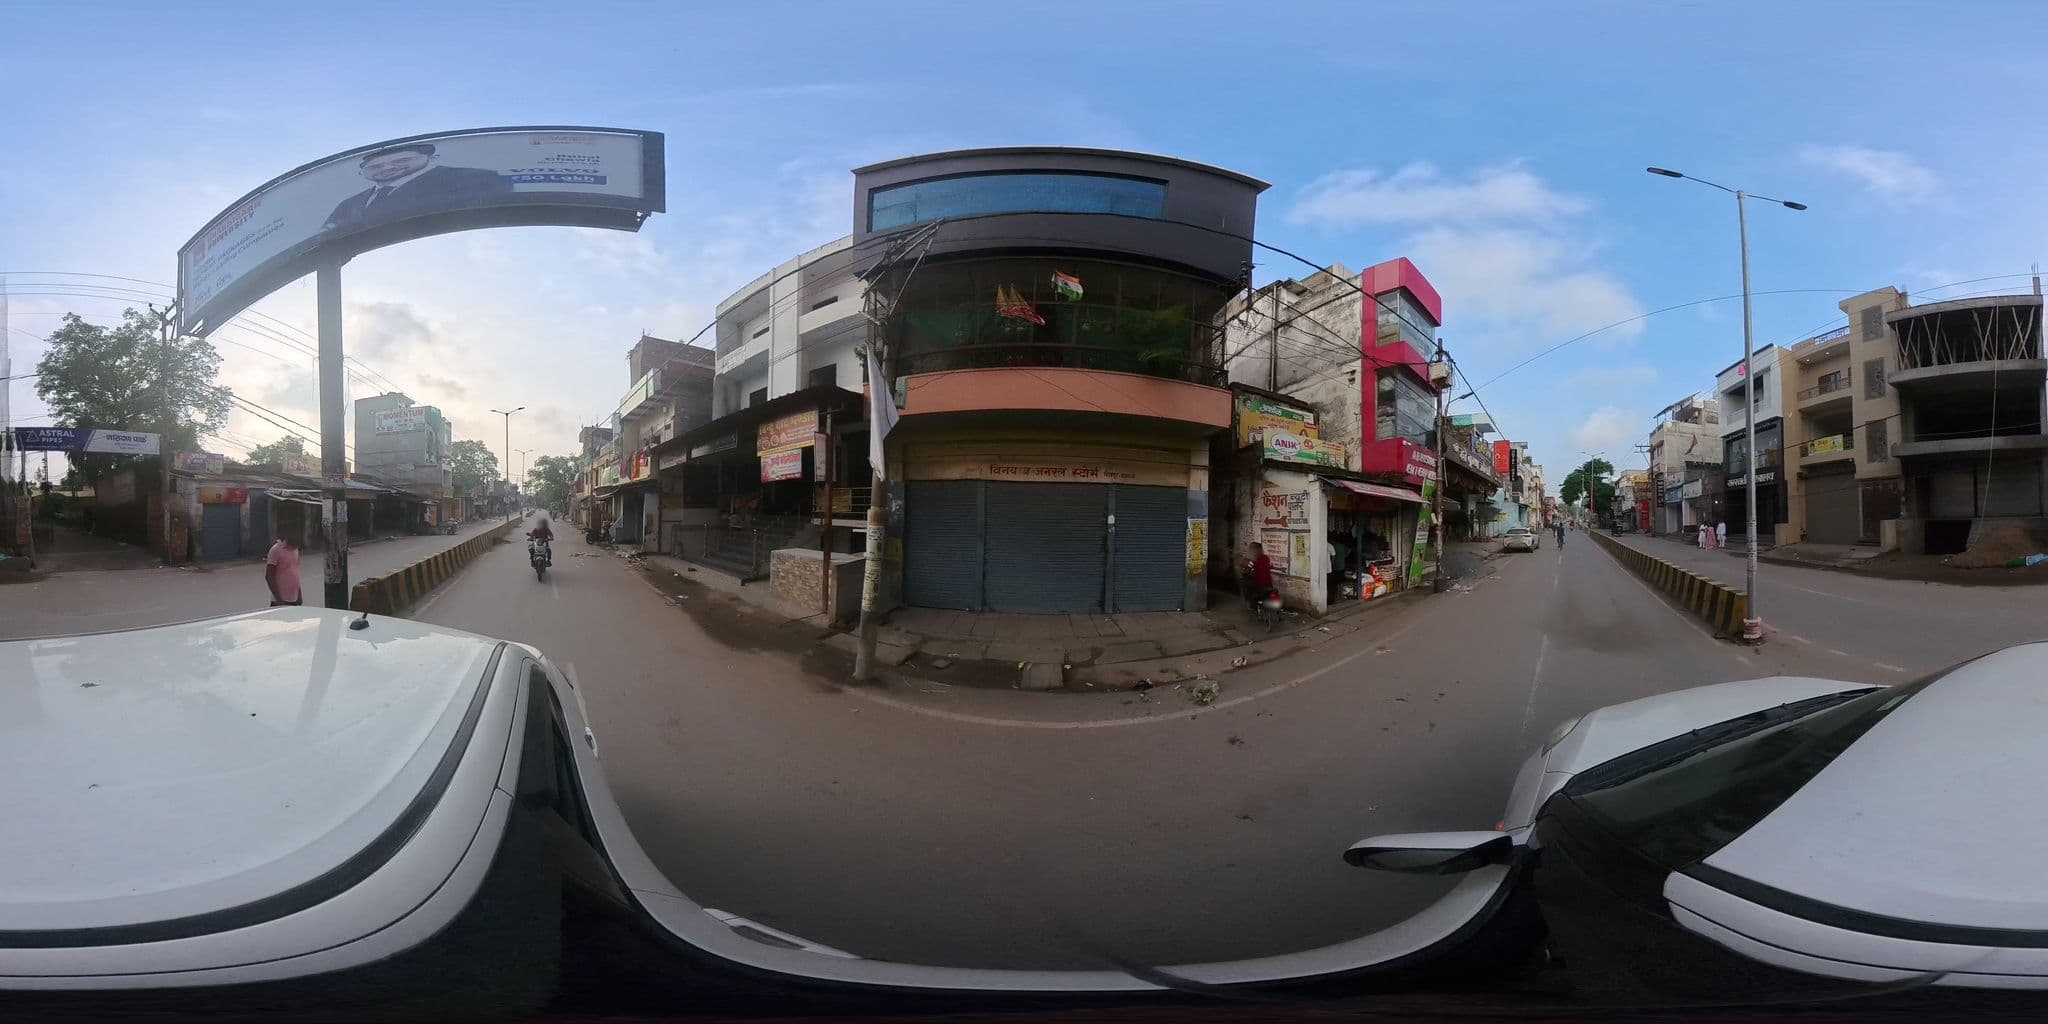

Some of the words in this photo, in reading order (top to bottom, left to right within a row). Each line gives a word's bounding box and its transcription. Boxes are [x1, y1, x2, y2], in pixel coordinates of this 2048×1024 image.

[384, 409, 424, 420] MOMENTUM
[38, 430, 75, 438] ASTRAL
[1274, 439, 1298, 449] ANIK
[990, 464, 1017, 475] विनय
[1034, 465, 1067, 477] जनरल
[1072, 465, 1100, 478] स्टोर्स
[1263, 490, 1288, 510] फैशन
